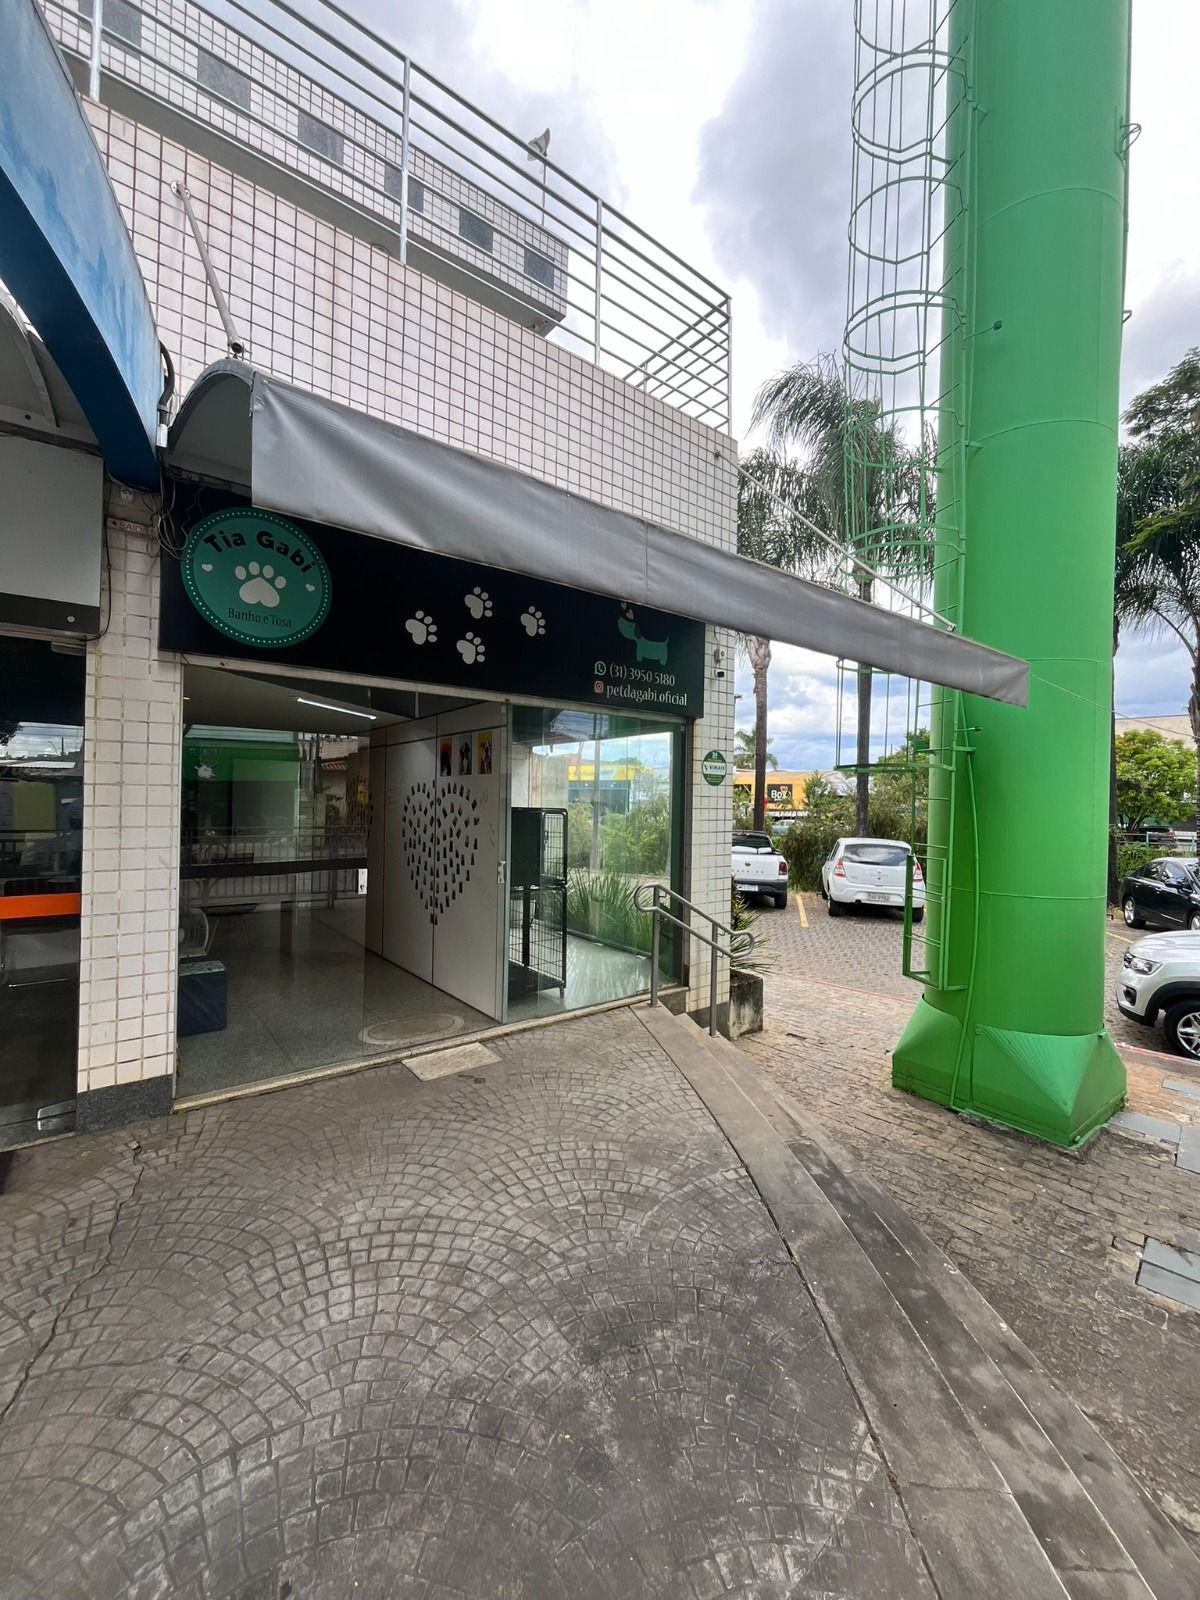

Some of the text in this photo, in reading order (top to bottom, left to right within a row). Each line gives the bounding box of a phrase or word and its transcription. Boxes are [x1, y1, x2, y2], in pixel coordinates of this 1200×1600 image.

[203, 530, 316, 573] Tia Gabi
[228, 607, 292, 628] Banho e Tosa
[609, 662, 676, 687] (31) 3950 5180
[606, 684, 688, 706] petdagabi.oficial
